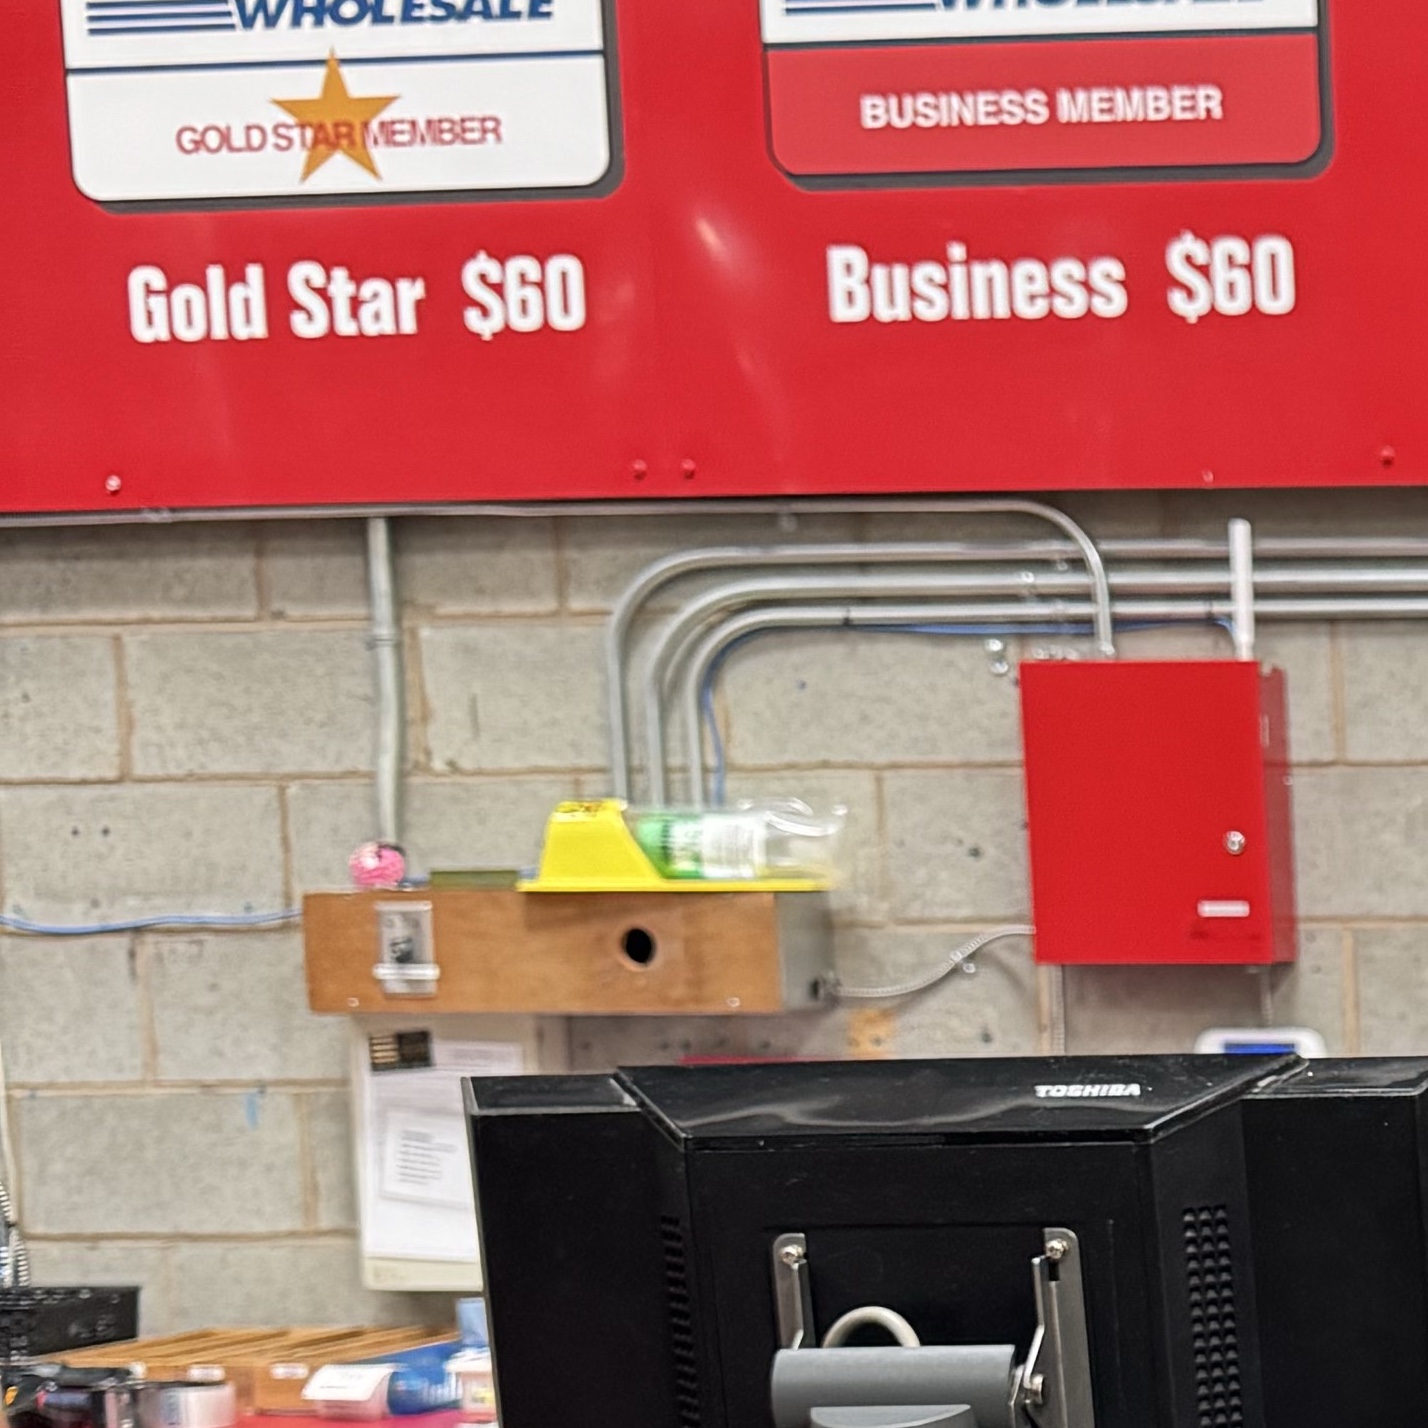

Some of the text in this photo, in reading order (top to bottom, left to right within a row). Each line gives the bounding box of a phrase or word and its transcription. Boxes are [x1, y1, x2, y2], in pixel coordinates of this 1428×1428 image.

[860, 84, 1225, 130] BUSINESS MEMBER
[174, 116, 504, 154] GOLD STAR MEMBER
[127, 249, 587, 343] Gold Star $60
[825, 229, 1297, 324] Business $60
[1034, 1083, 1141, 1098] TOSHIBA
